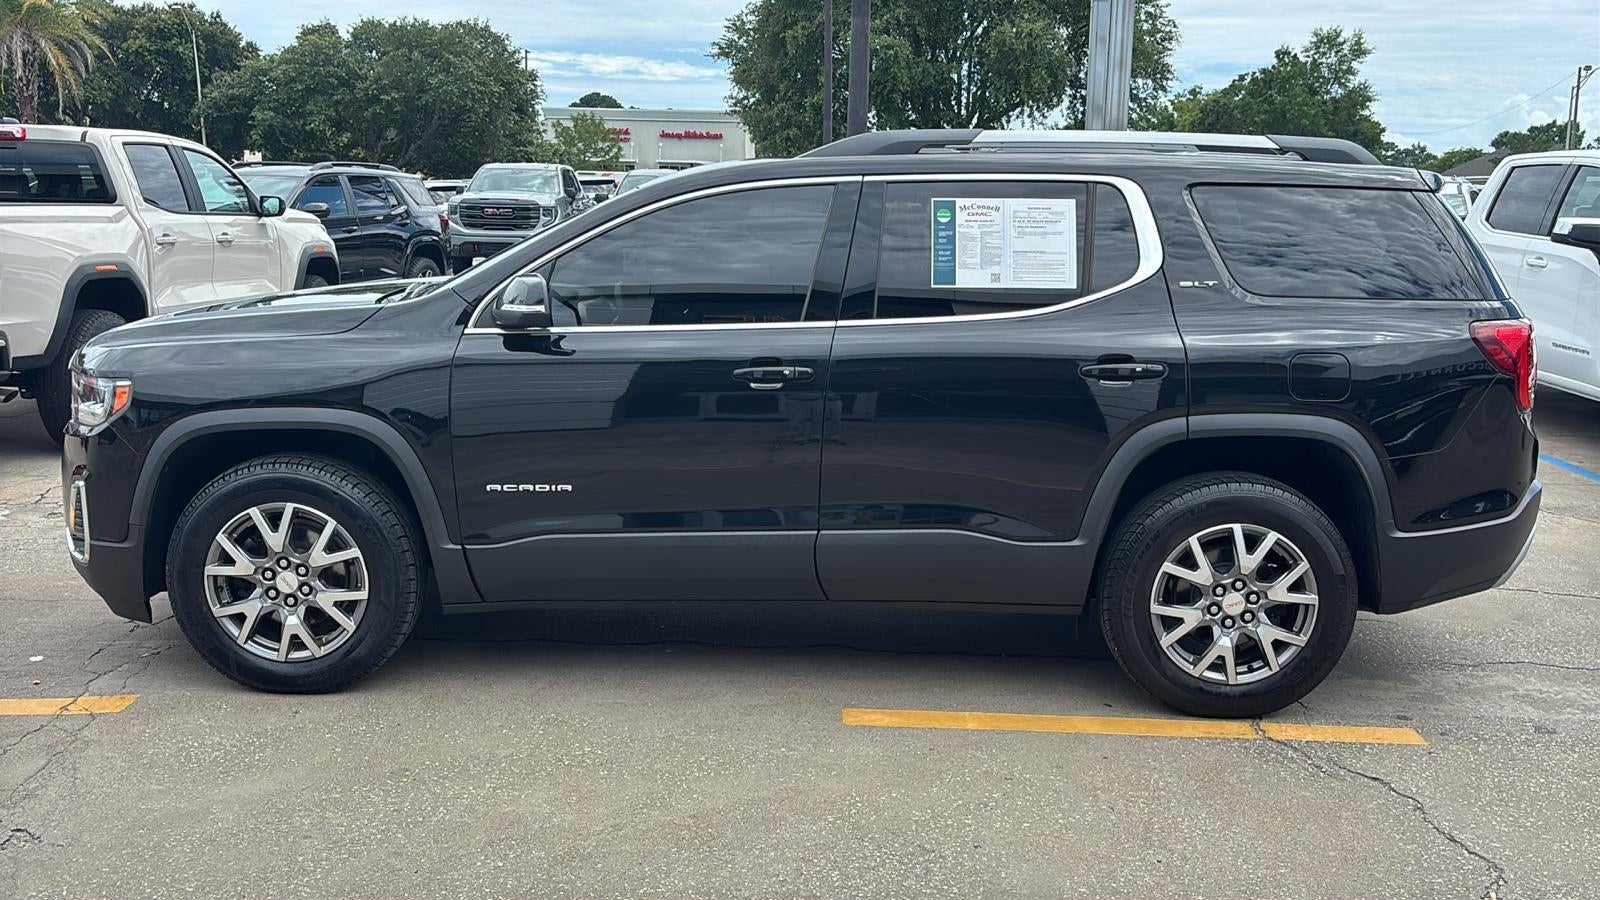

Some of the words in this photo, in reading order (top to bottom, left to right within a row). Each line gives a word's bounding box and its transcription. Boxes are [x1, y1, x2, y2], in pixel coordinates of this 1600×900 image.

[659, 130, 683, 140] Jersey
[958, 202, 1001, 213] McConnell
[1179, 280, 1219, 288] SLT
[486, 484, 573, 492] ACADIA
[1224, 600, 1244, 609] GMC
